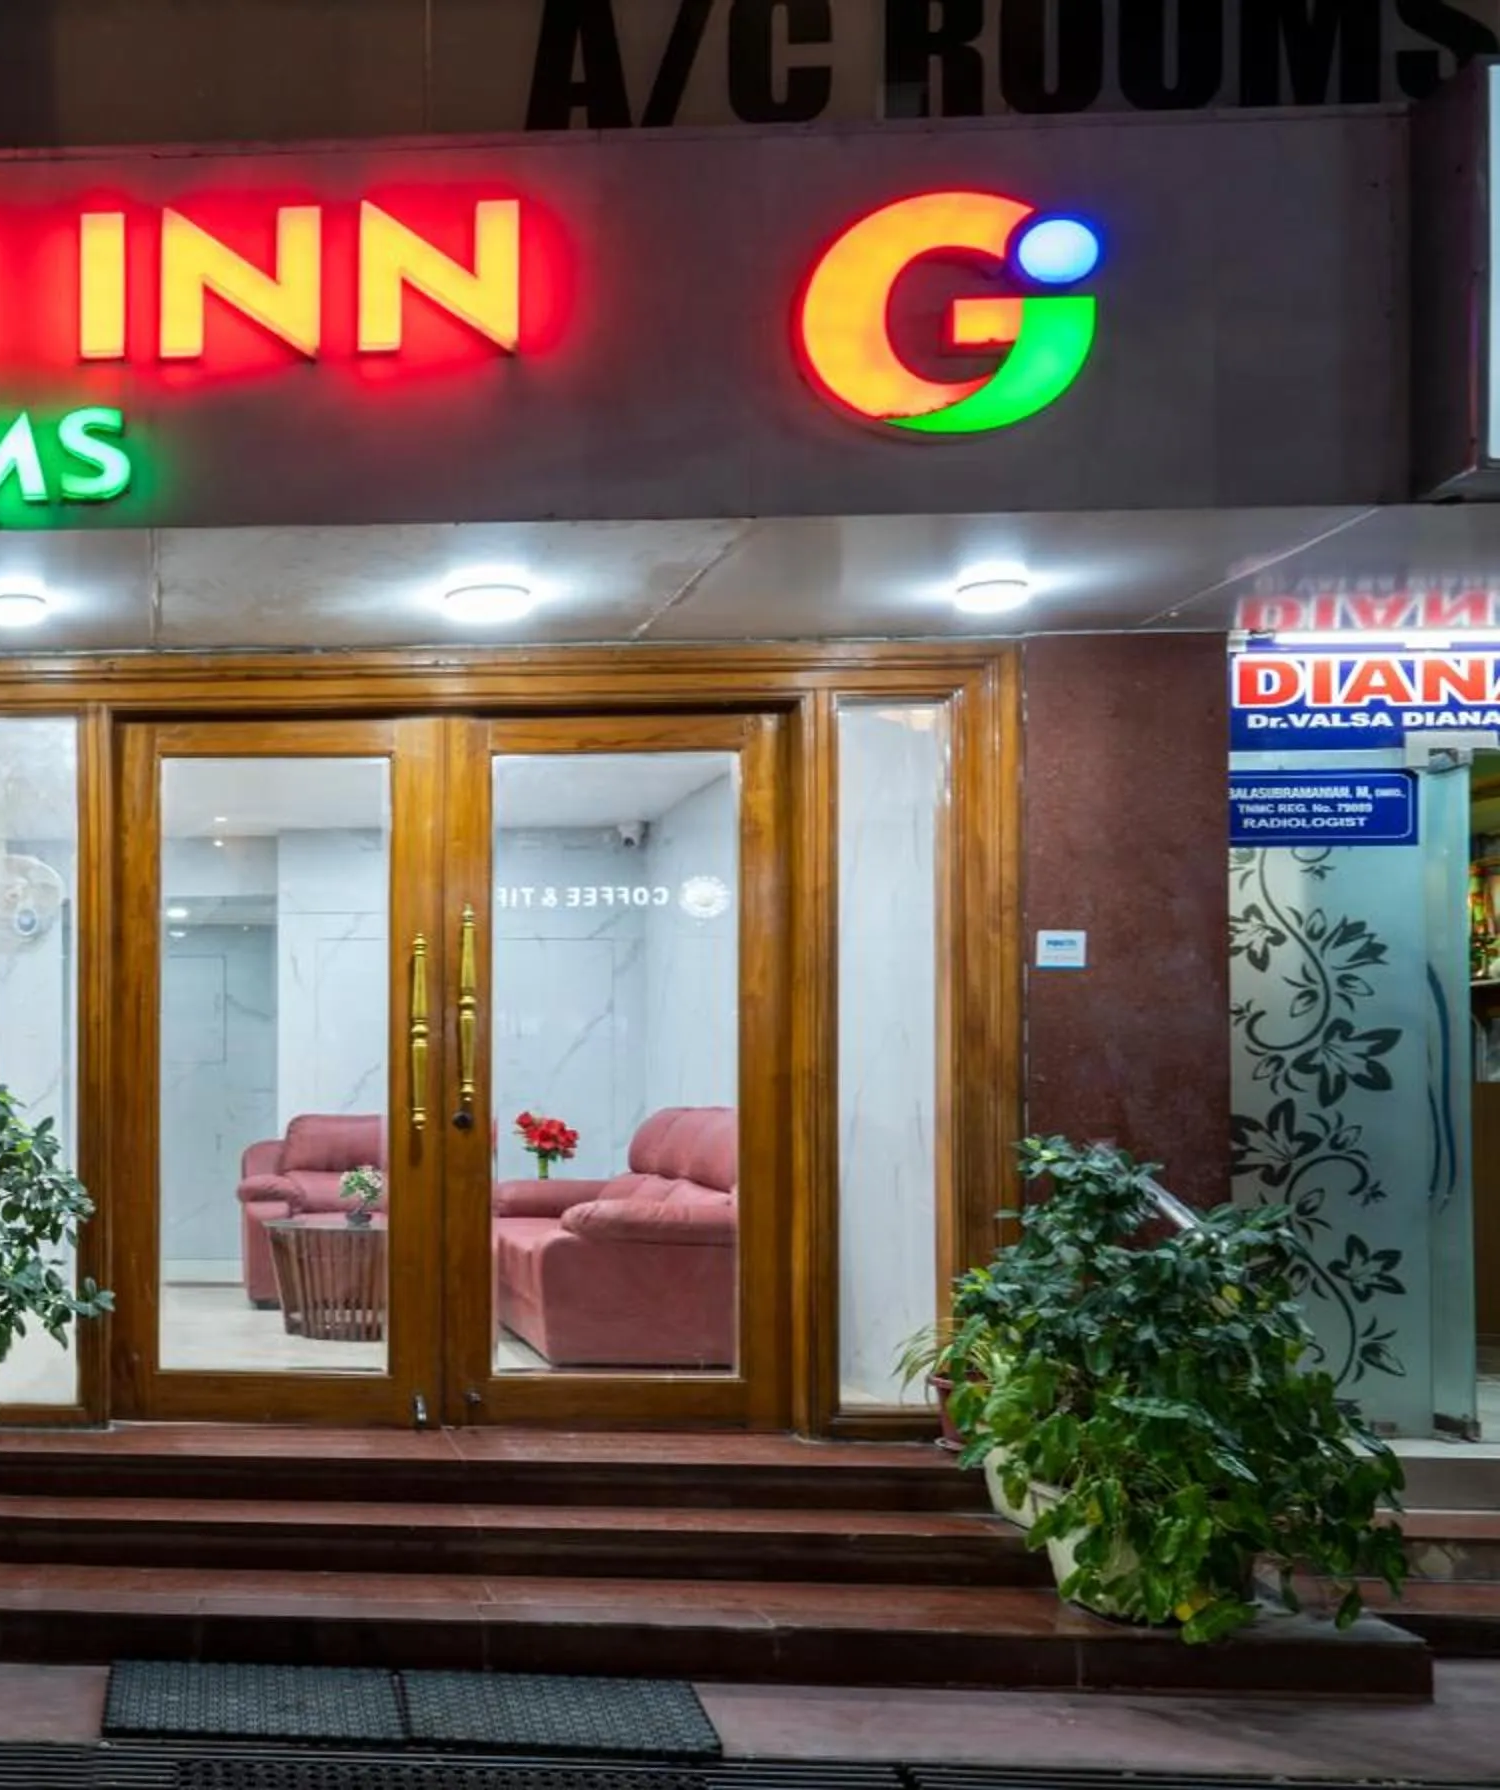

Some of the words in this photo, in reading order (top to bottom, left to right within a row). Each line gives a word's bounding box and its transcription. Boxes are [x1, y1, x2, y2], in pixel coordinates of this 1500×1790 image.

[80, 199, 520, 361] INN
[1234, 655, 1500, 707] DIAN
[1242, 816, 1368, 829] RADIOLOGIST
